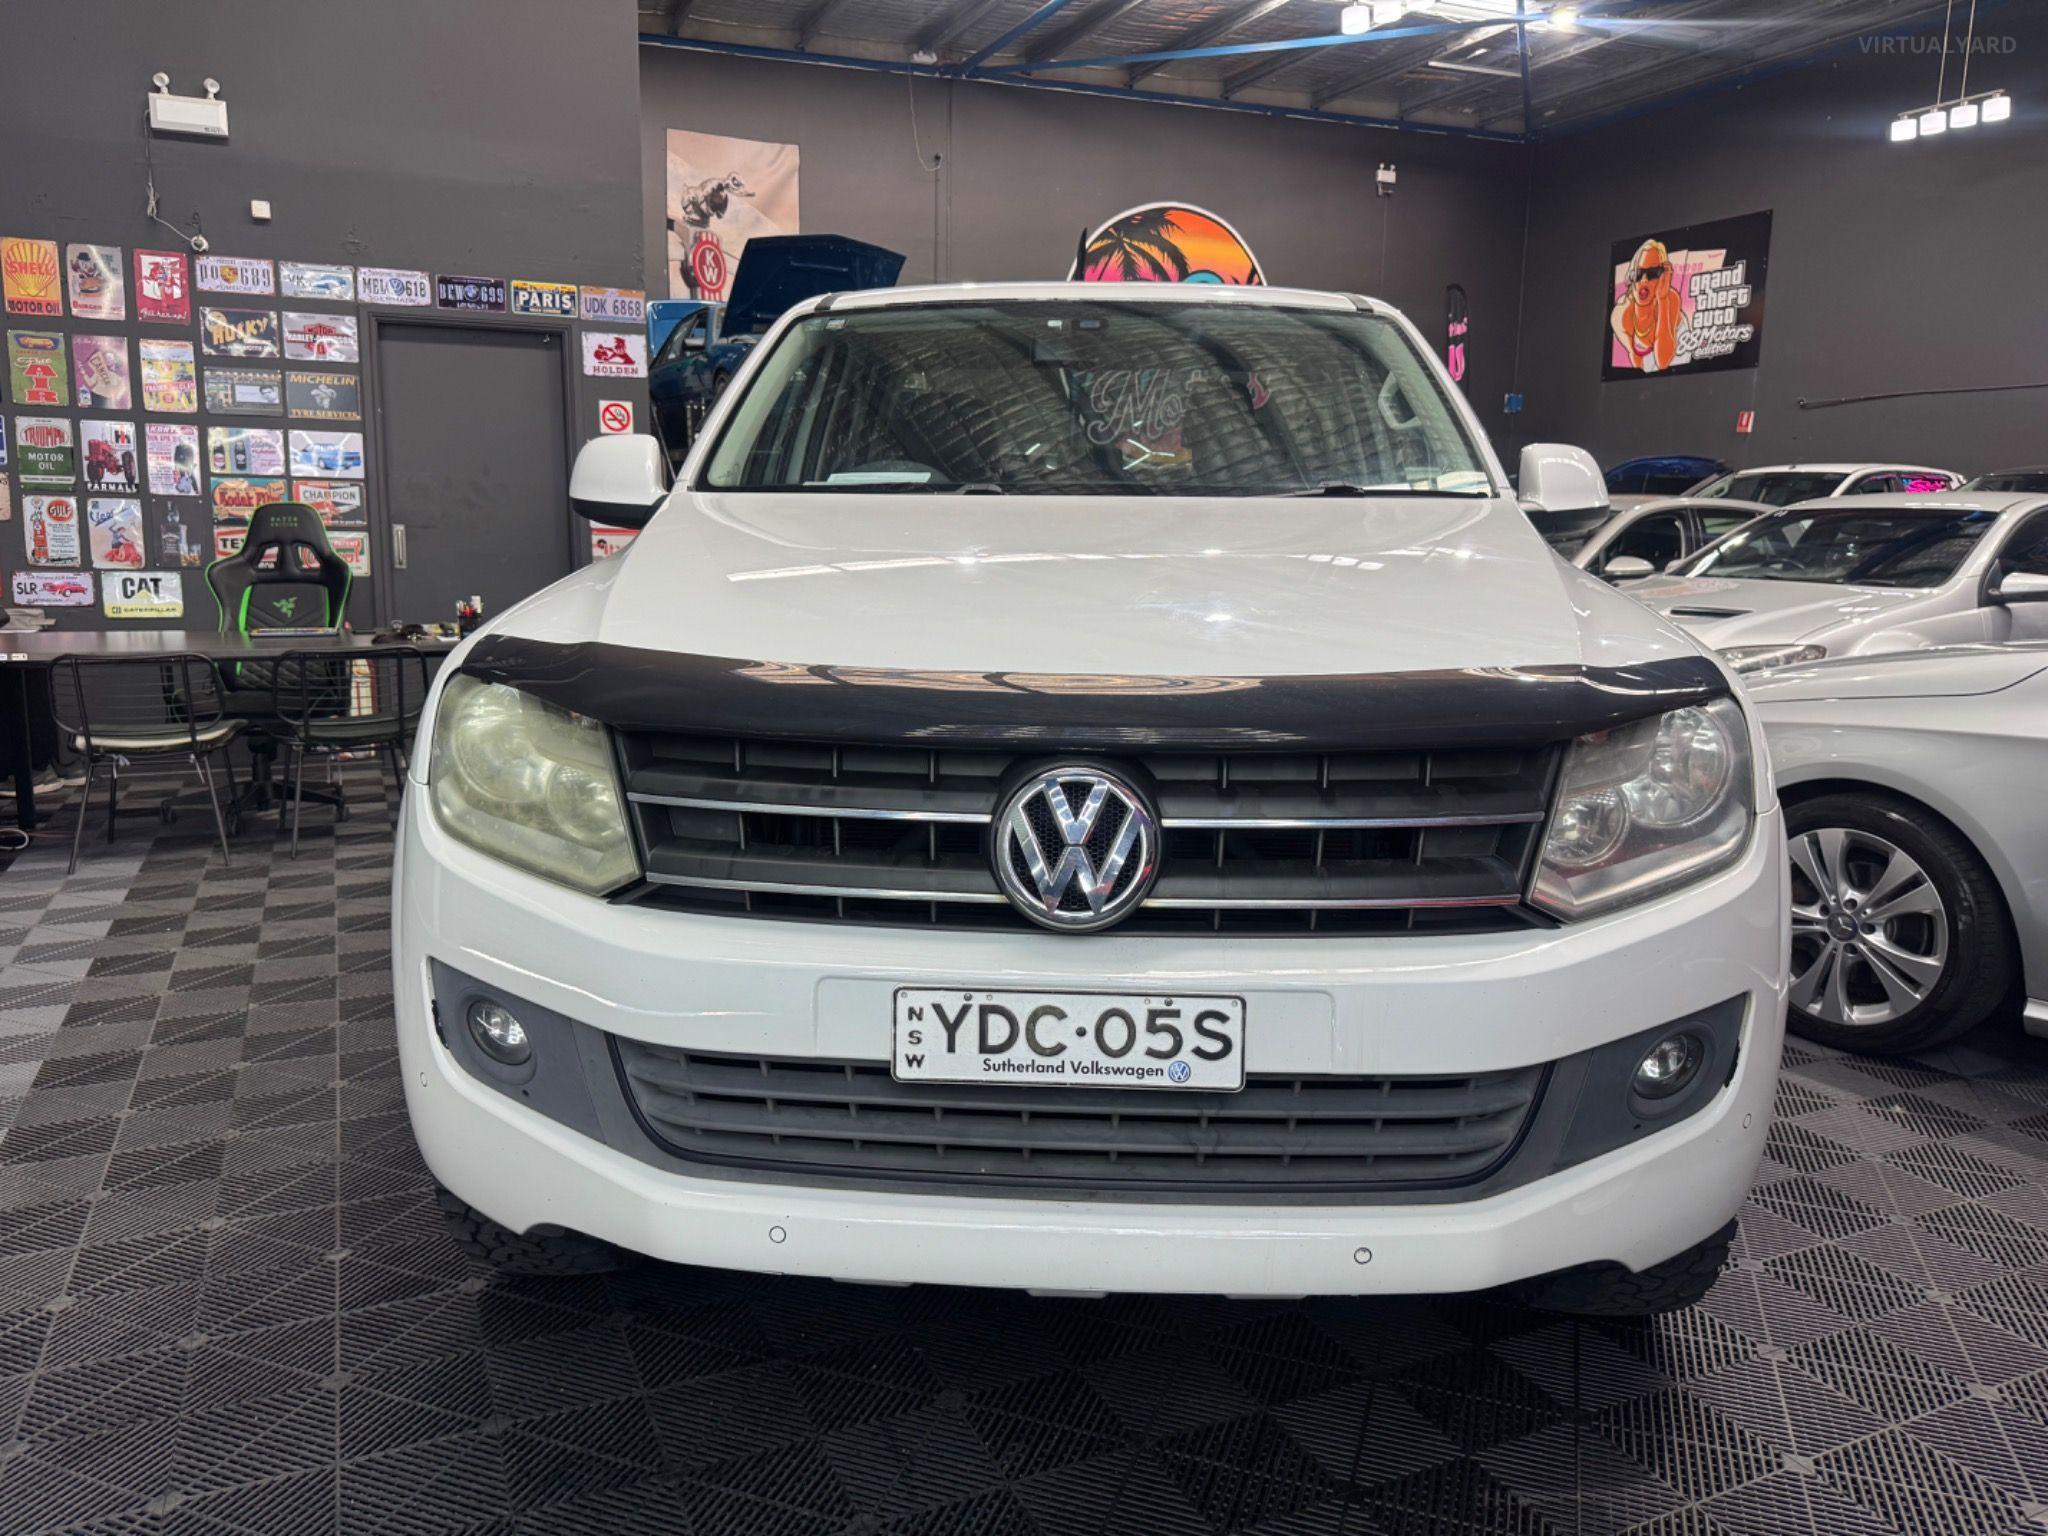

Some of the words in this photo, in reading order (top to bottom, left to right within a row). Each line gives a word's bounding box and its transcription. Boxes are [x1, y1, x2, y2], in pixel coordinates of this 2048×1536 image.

[10, 262, 51, 275] SHELL
[8, 300, 43, 312] MOTOR
[46, 301, 60, 313] OIL
[518, 290, 572, 310] PARIS
[585, 297, 608, 314] UDK
[613, 299, 642, 317] 6868
[592, 366, 639, 375] HOLDEN
[290, 374, 355, 386] MICHELIN
[24, 426, 65, 448] TRIUMPH
[28, 453, 64, 462] MOTOR
[38, 462, 55, 470] OIL
[87, 482, 138, 493] FARMALL
[303, 490, 357, 501] CHAMPION
[48, 504, 73, 517] GULF
[16, 582, 38, 595] SLR
[121, 577, 162, 599] CAT
[982, 1058, 1065, 1075] Sutherland
[1070, 1060, 1164, 1078] Volkswagen
